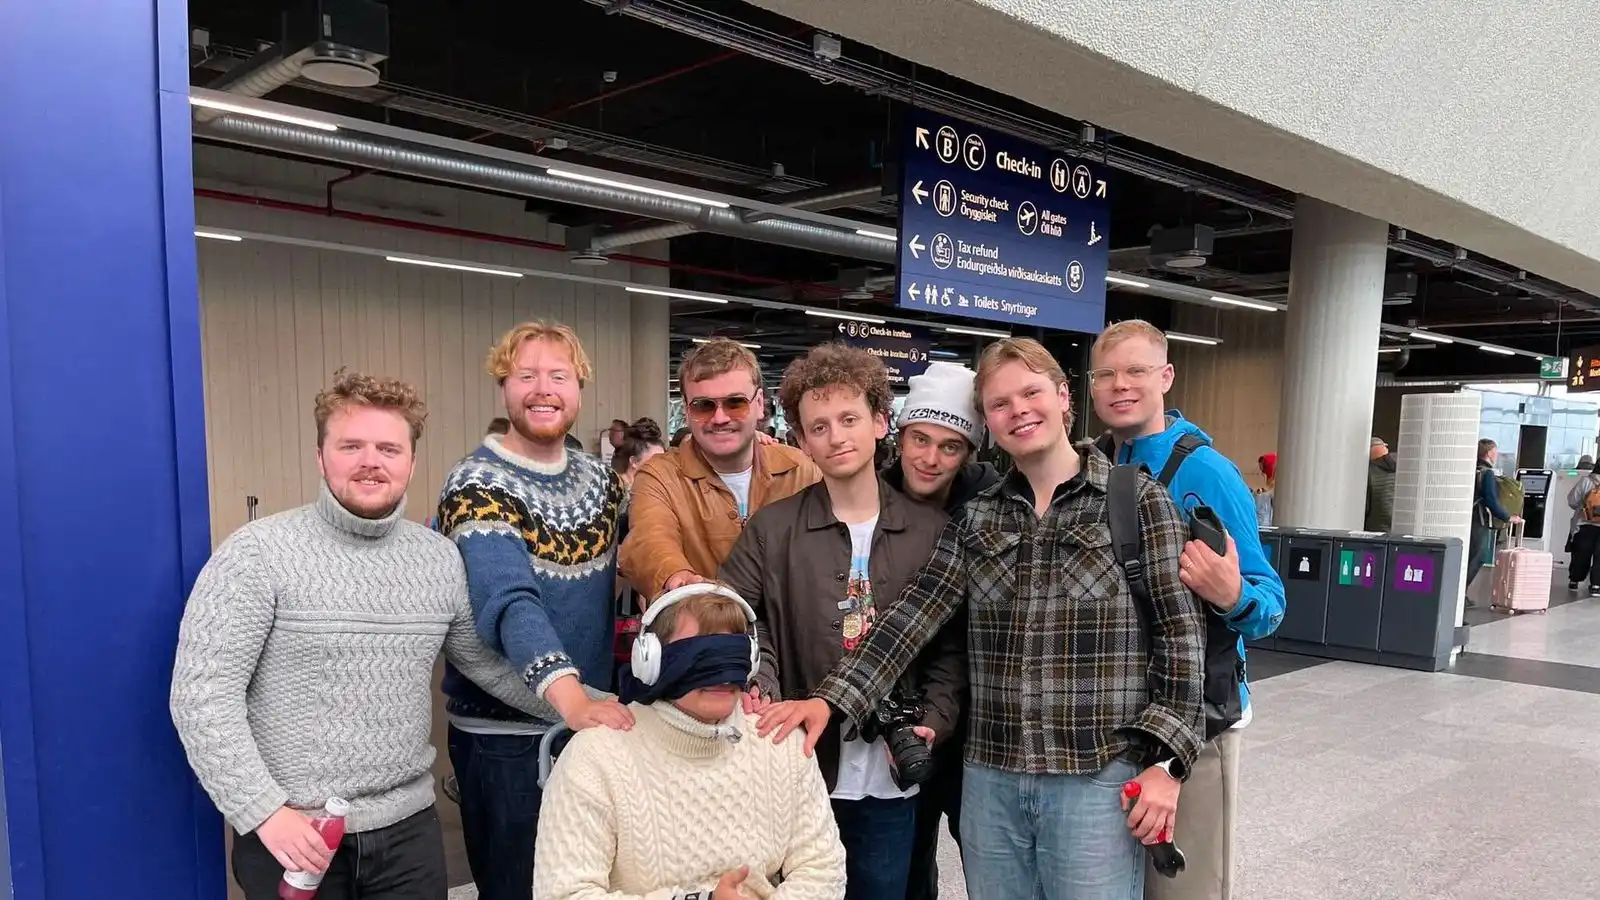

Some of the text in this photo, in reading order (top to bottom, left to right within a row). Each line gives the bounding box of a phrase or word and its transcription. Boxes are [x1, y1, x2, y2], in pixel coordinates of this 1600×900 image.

[943, 137, 953, 158] B
[969, 146, 980, 166] C
[996, 151, 1042, 179] Check-in
[1077, 176, 1087, 194] A
[961, 189, 1009, 212] Security check
[1041, 210, 1067, 225] All gates
[957, 240, 999, 259] Tax refund
[957, 256, 1063, 286] Endurgreiðsla virðisaukaskatts
[973, 295, 1038, 318] Toilets Snyrtingar
[850, 325, 856, 335] B
[861, 326, 867, 336] C
[870, 326, 892, 337] Check-in
[867, 347, 889, 357] Check-in
[911, 352, 917, 360] A
